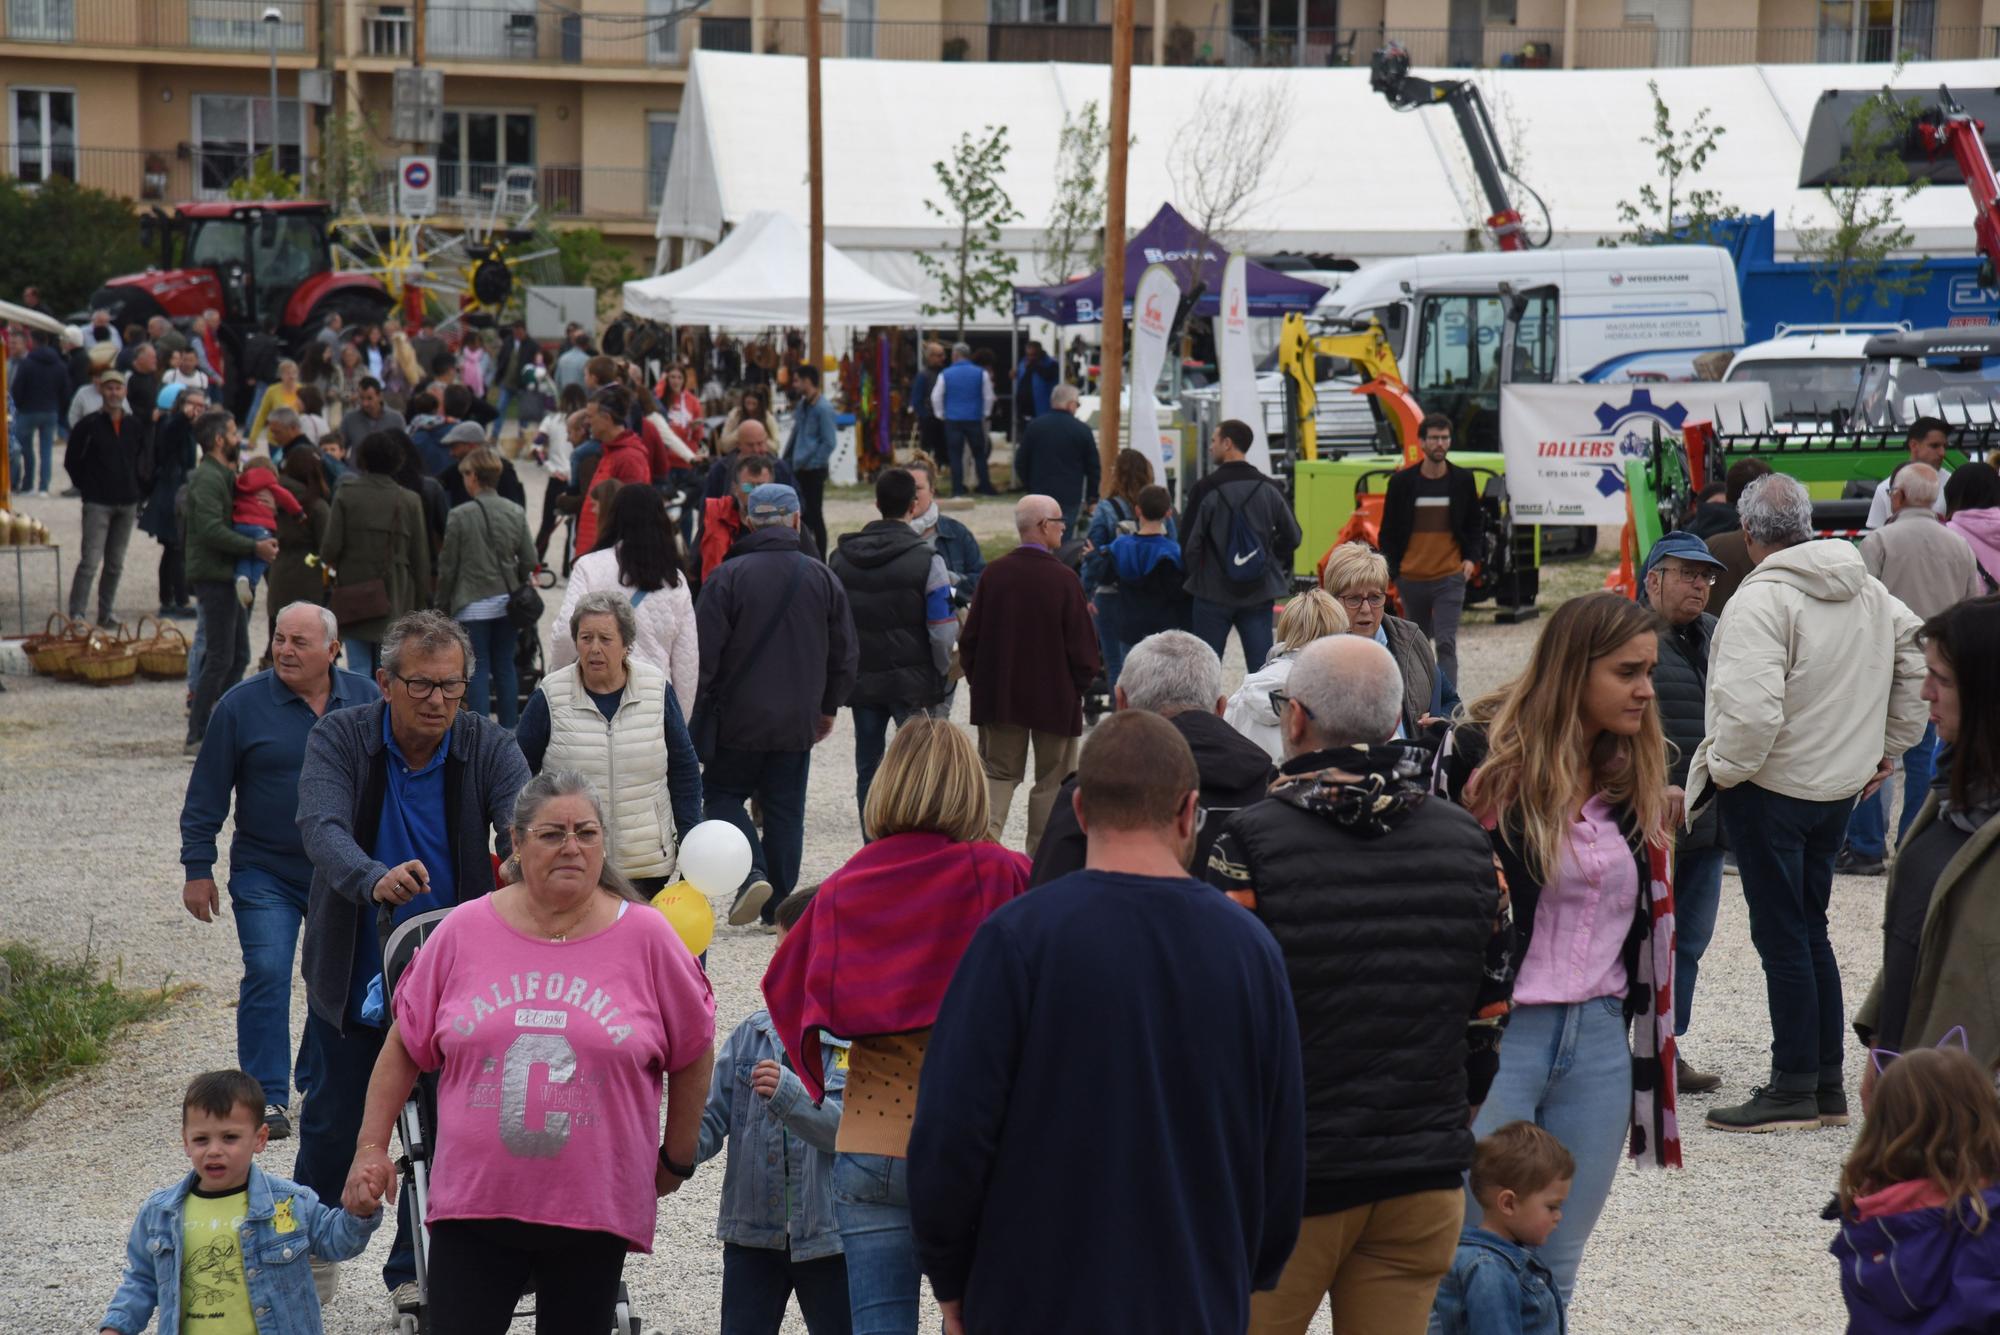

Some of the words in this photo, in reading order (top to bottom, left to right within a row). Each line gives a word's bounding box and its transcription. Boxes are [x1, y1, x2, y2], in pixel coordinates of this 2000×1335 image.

[1627, 274, 1689, 283] WEIDEMANN
[1537, 441, 1616, 457] TALLERS
[1515, 504, 1543, 512] DEUTZ
[1558, 504, 1583, 512] FAHR
[451, 971, 635, 1046] CALIFORNIA
